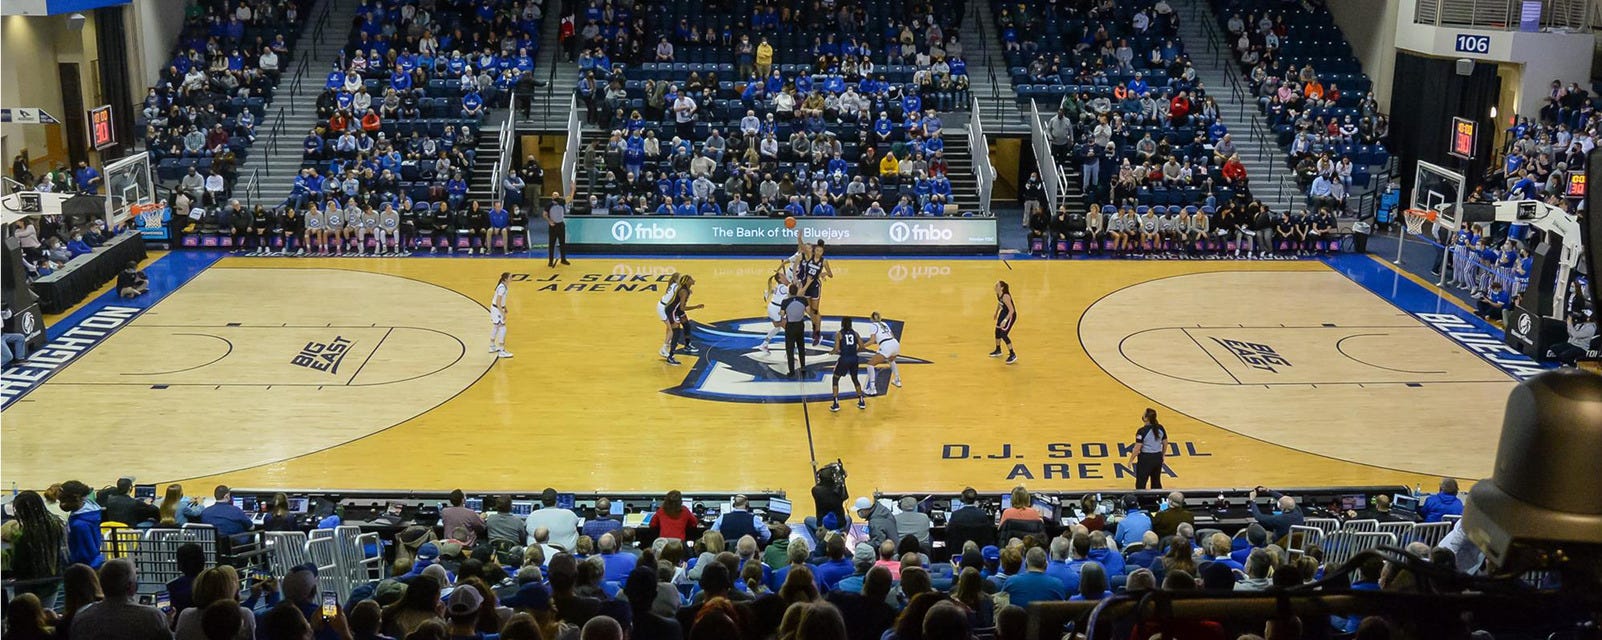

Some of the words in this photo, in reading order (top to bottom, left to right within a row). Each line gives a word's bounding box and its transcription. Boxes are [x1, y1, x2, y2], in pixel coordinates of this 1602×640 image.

[1458, 36, 1488, 52] 106
[1571, 183, 1585, 195] 30
[635, 224, 677, 240] fnbo
[712, 227, 733, 237] The
[737, 227, 764, 237] Bank
[767, 227, 780, 237] of
[782, 227, 799, 238] the
[803, 227, 850, 239] Bluejays
[912, 225, 953, 241] fnbo
[579, 274, 675, 282] SOKO
[535, 283, 659, 292] ARENA
[844, 334, 855, 346] 13
[1414, 312, 1553, 380] BLUEJA
[290, 341, 327, 368] BIG
[309, 335, 352, 372] EAST
[1222, 338, 1279, 374] EAST
[1245, 341, 1293, 367] BIG
[941, 443, 1024, 460] D.J.
